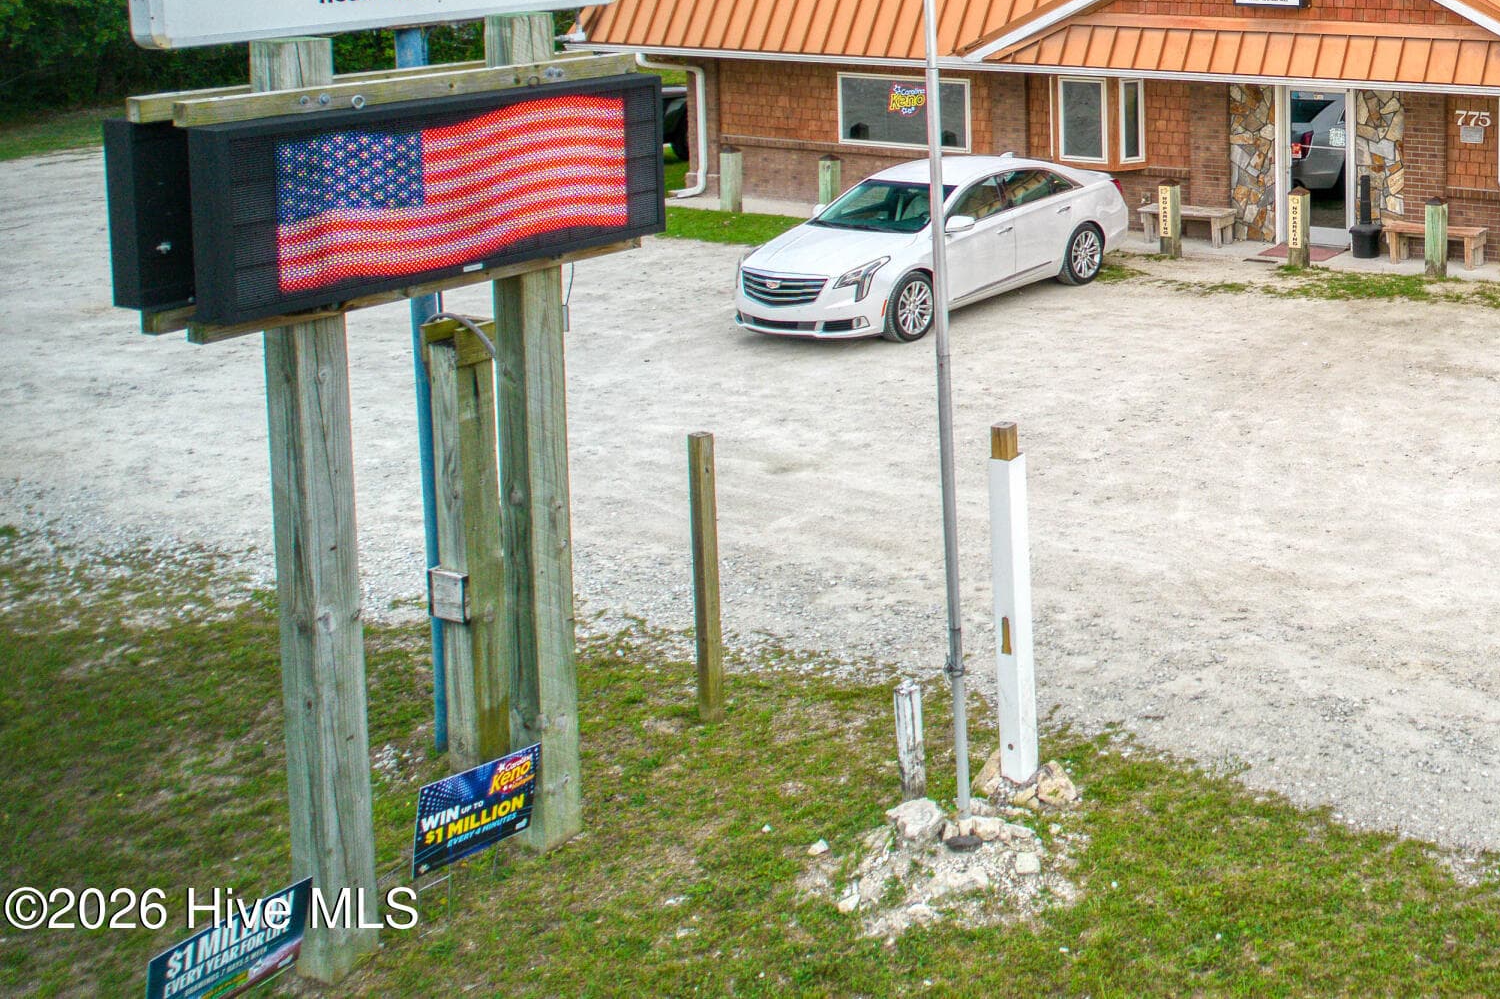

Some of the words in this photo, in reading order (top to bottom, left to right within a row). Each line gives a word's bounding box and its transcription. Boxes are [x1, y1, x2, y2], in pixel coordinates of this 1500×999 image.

[888, 93, 926, 111] Keno
[1455, 110, 1492, 127] 775
[1162, 196, 1168, 205] NO
[1292, 206, 1298, 215] NO
[489, 760, 532, 795] Keno
[421, 805, 460, 832] WIN
[425, 826, 443, 845] $1
[447, 793, 525, 839] MILLION
[163, 962, 206, 999] EVERY
[205, 945, 239, 974] YEAR
[240, 931, 265, 952] FOR
[165, 940, 195, 981] $1
